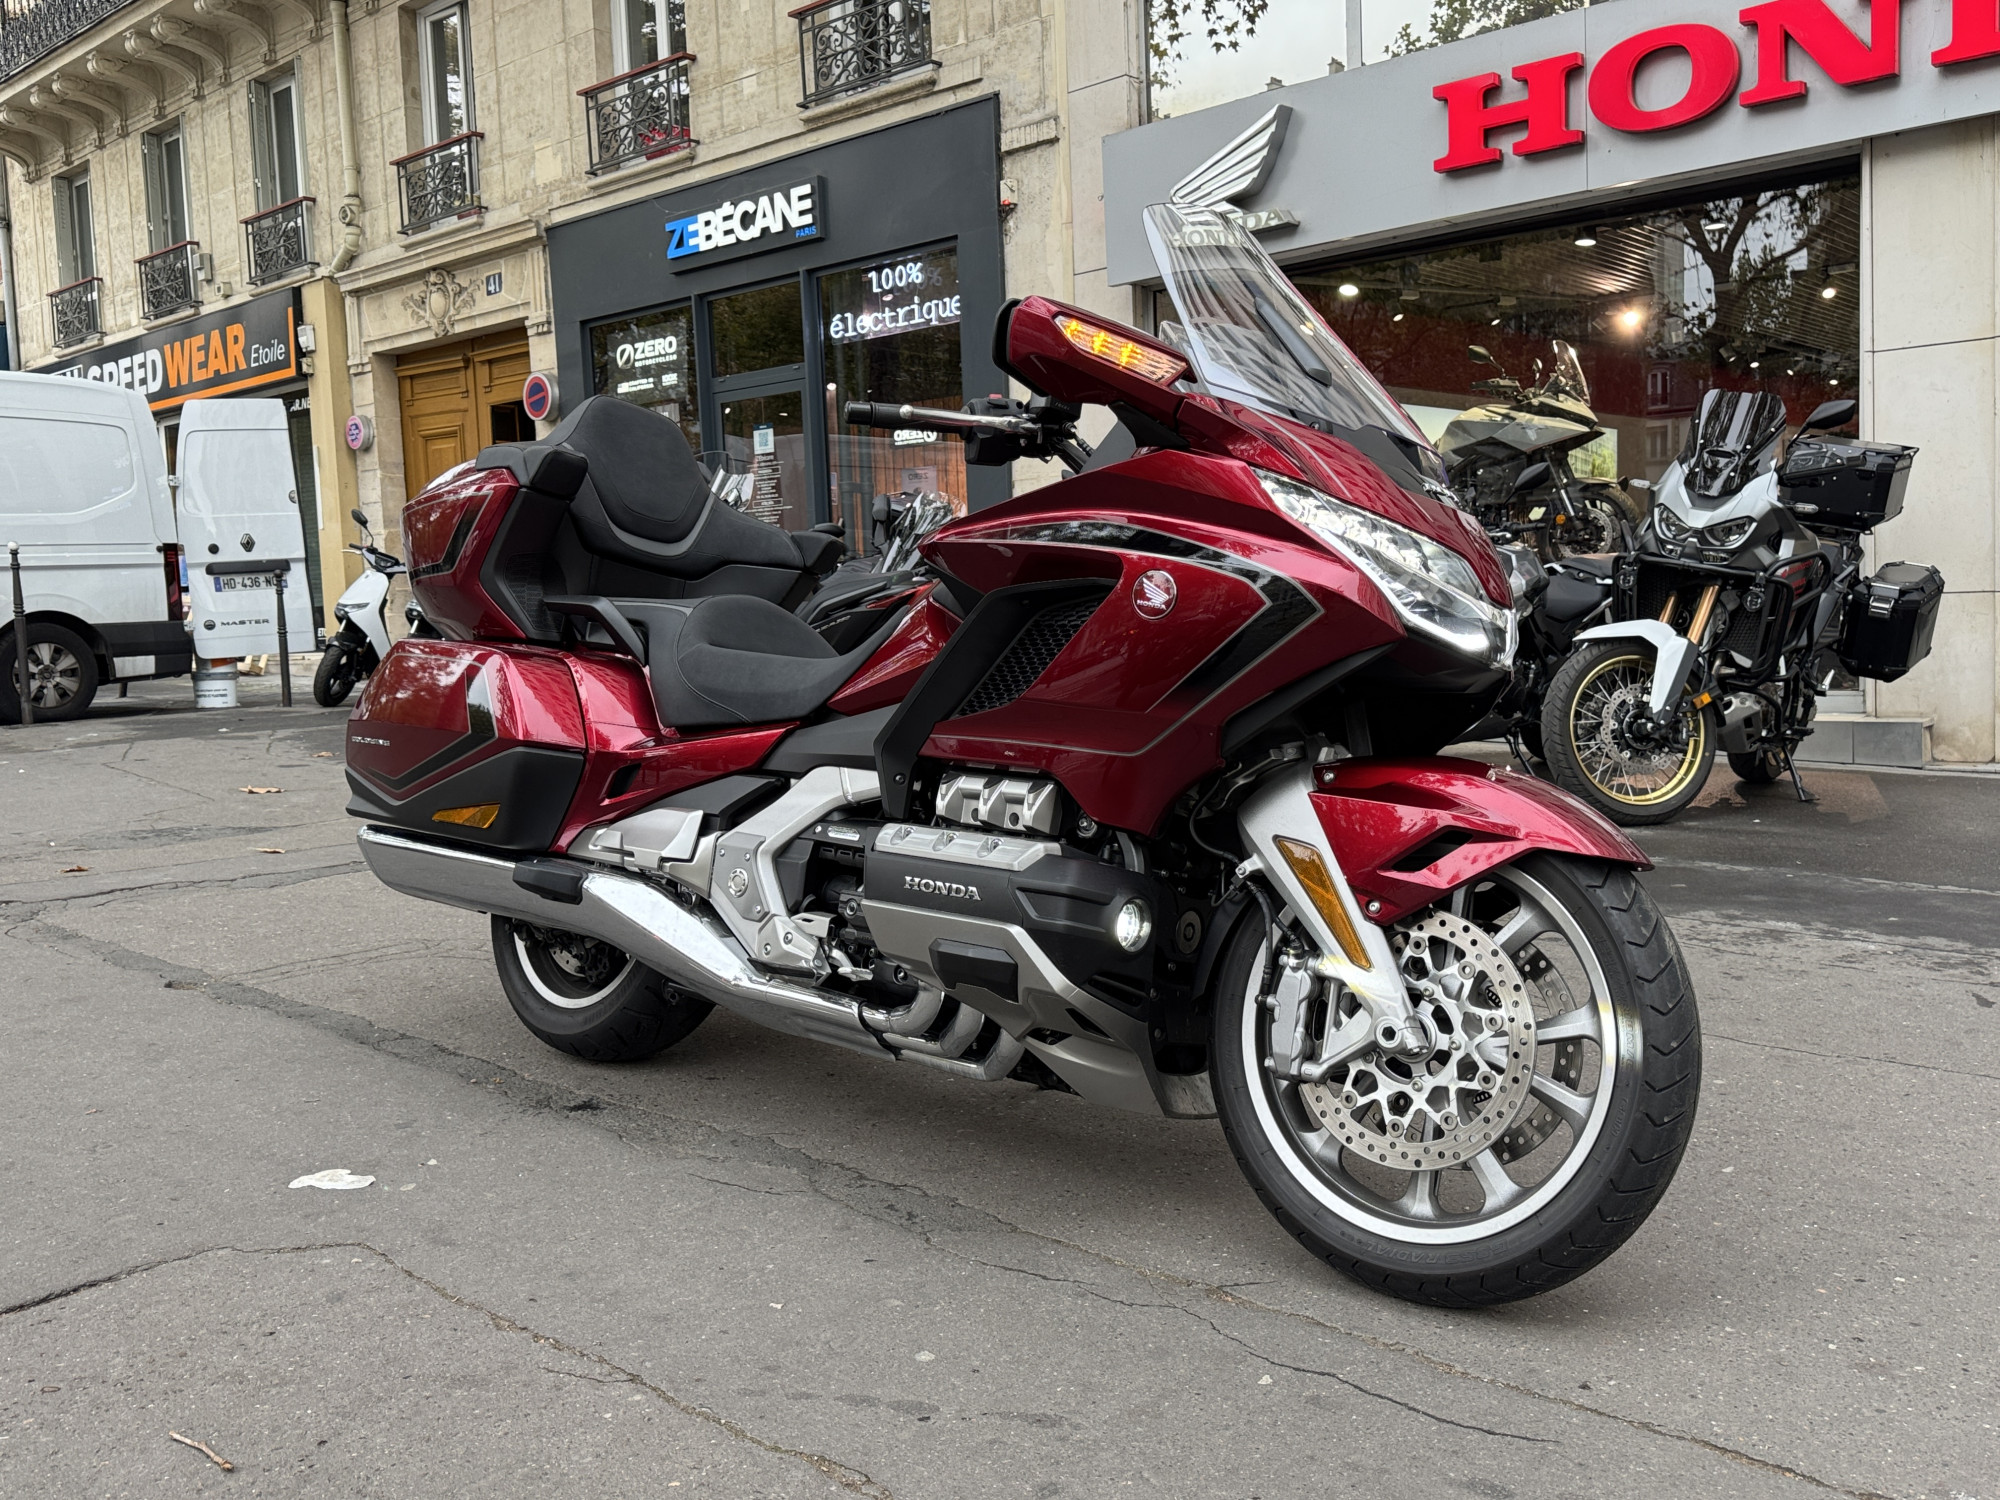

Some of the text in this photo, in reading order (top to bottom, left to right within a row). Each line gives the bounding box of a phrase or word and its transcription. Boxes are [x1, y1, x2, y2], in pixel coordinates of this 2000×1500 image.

[665, 183, 814, 259] ZEBÉCANE
[796, 226, 817, 238] PARIS
[488, 274, 500, 293] 41
[868, 262, 924, 293] 100%
[830, 294, 961, 339] électrique
[250, 339, 286, 367] Etoile
[634, 335, 677, 360] ZERO
[1137, 599, 1167, 610] HONDA
[220, 618, 270, 627] MASTER
[904, 876, 982, 901] HONDA
